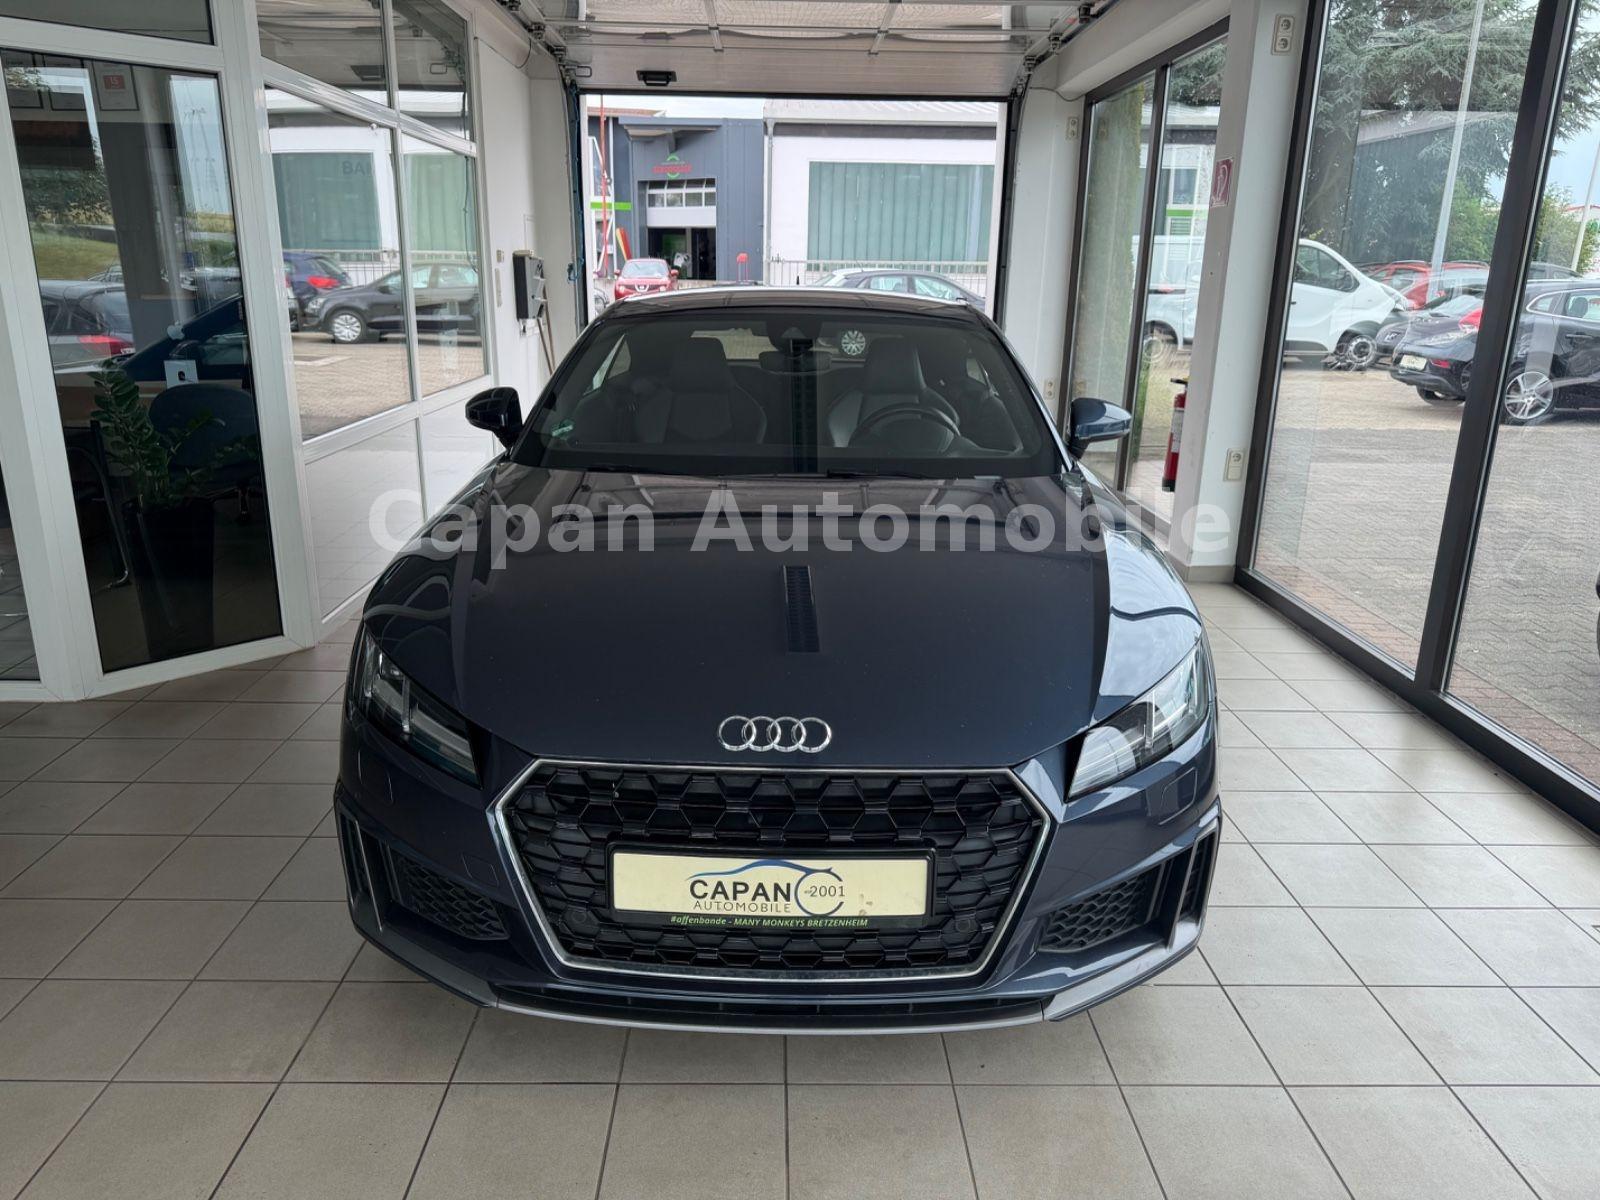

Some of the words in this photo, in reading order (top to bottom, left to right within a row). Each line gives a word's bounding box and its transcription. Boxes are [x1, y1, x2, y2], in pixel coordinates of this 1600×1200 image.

[689, 879, 791, 902] CAPAN
[809, 885, 845, 897] 2001
[693, 900, 791, 913] AUTOMOBILE
[734, 918, 760, 926] MANY
[763, 919, 804, 927] MONKEYS
[807, 919, 868, 927] BRETZENHEIM
